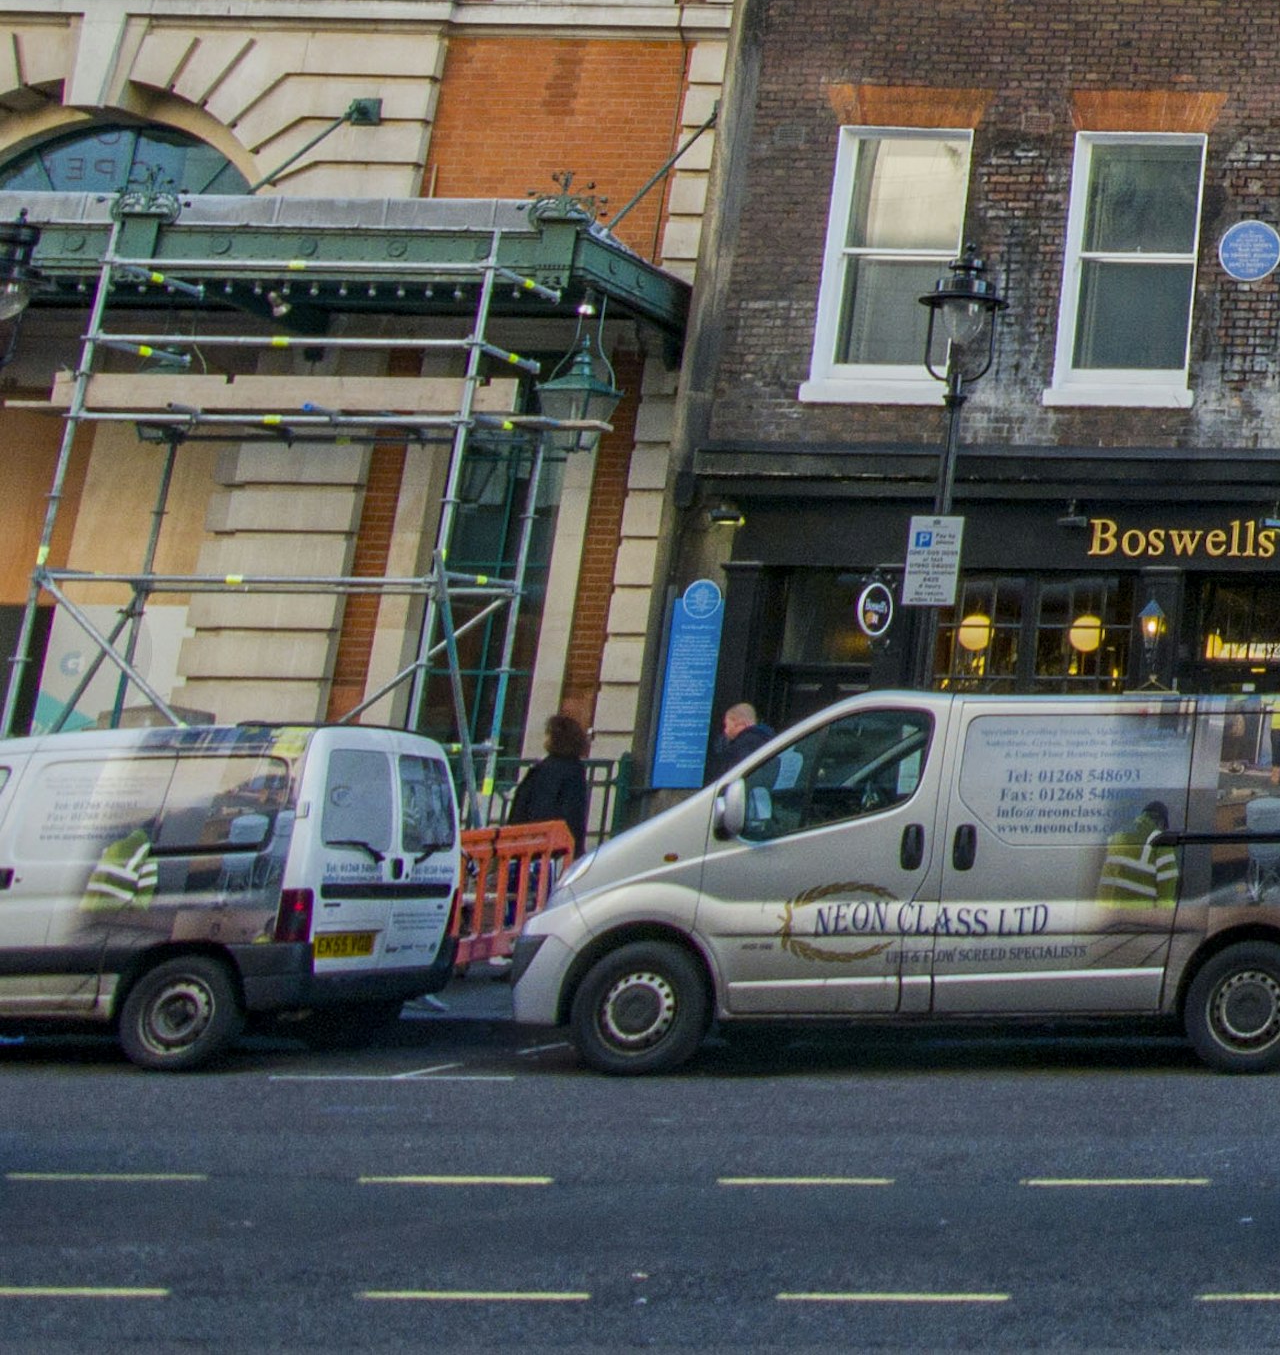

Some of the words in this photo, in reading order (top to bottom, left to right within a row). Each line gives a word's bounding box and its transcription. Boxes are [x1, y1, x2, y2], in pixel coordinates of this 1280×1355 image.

[1087, 518, 1276, 557] Boswells
[1006, 769, 1032, 783] Tel:
[1037, 769, 1083, 783] 01268
[1088, 768, 1141, 783] 548693
[1000, 788, 1034, 802] Fax:
[1039, 788, 1083, 802] 01268
[814, 899, 891, 935] NEON
[897, 899, 988, 936] CLASS
[998, 902, 1049, 935] LTD
[923, 948, 957, 963] FLOW
[958, 946, 1007, 961] SCREED
[1010, 945, 1087, 960] SPECIALISTS
